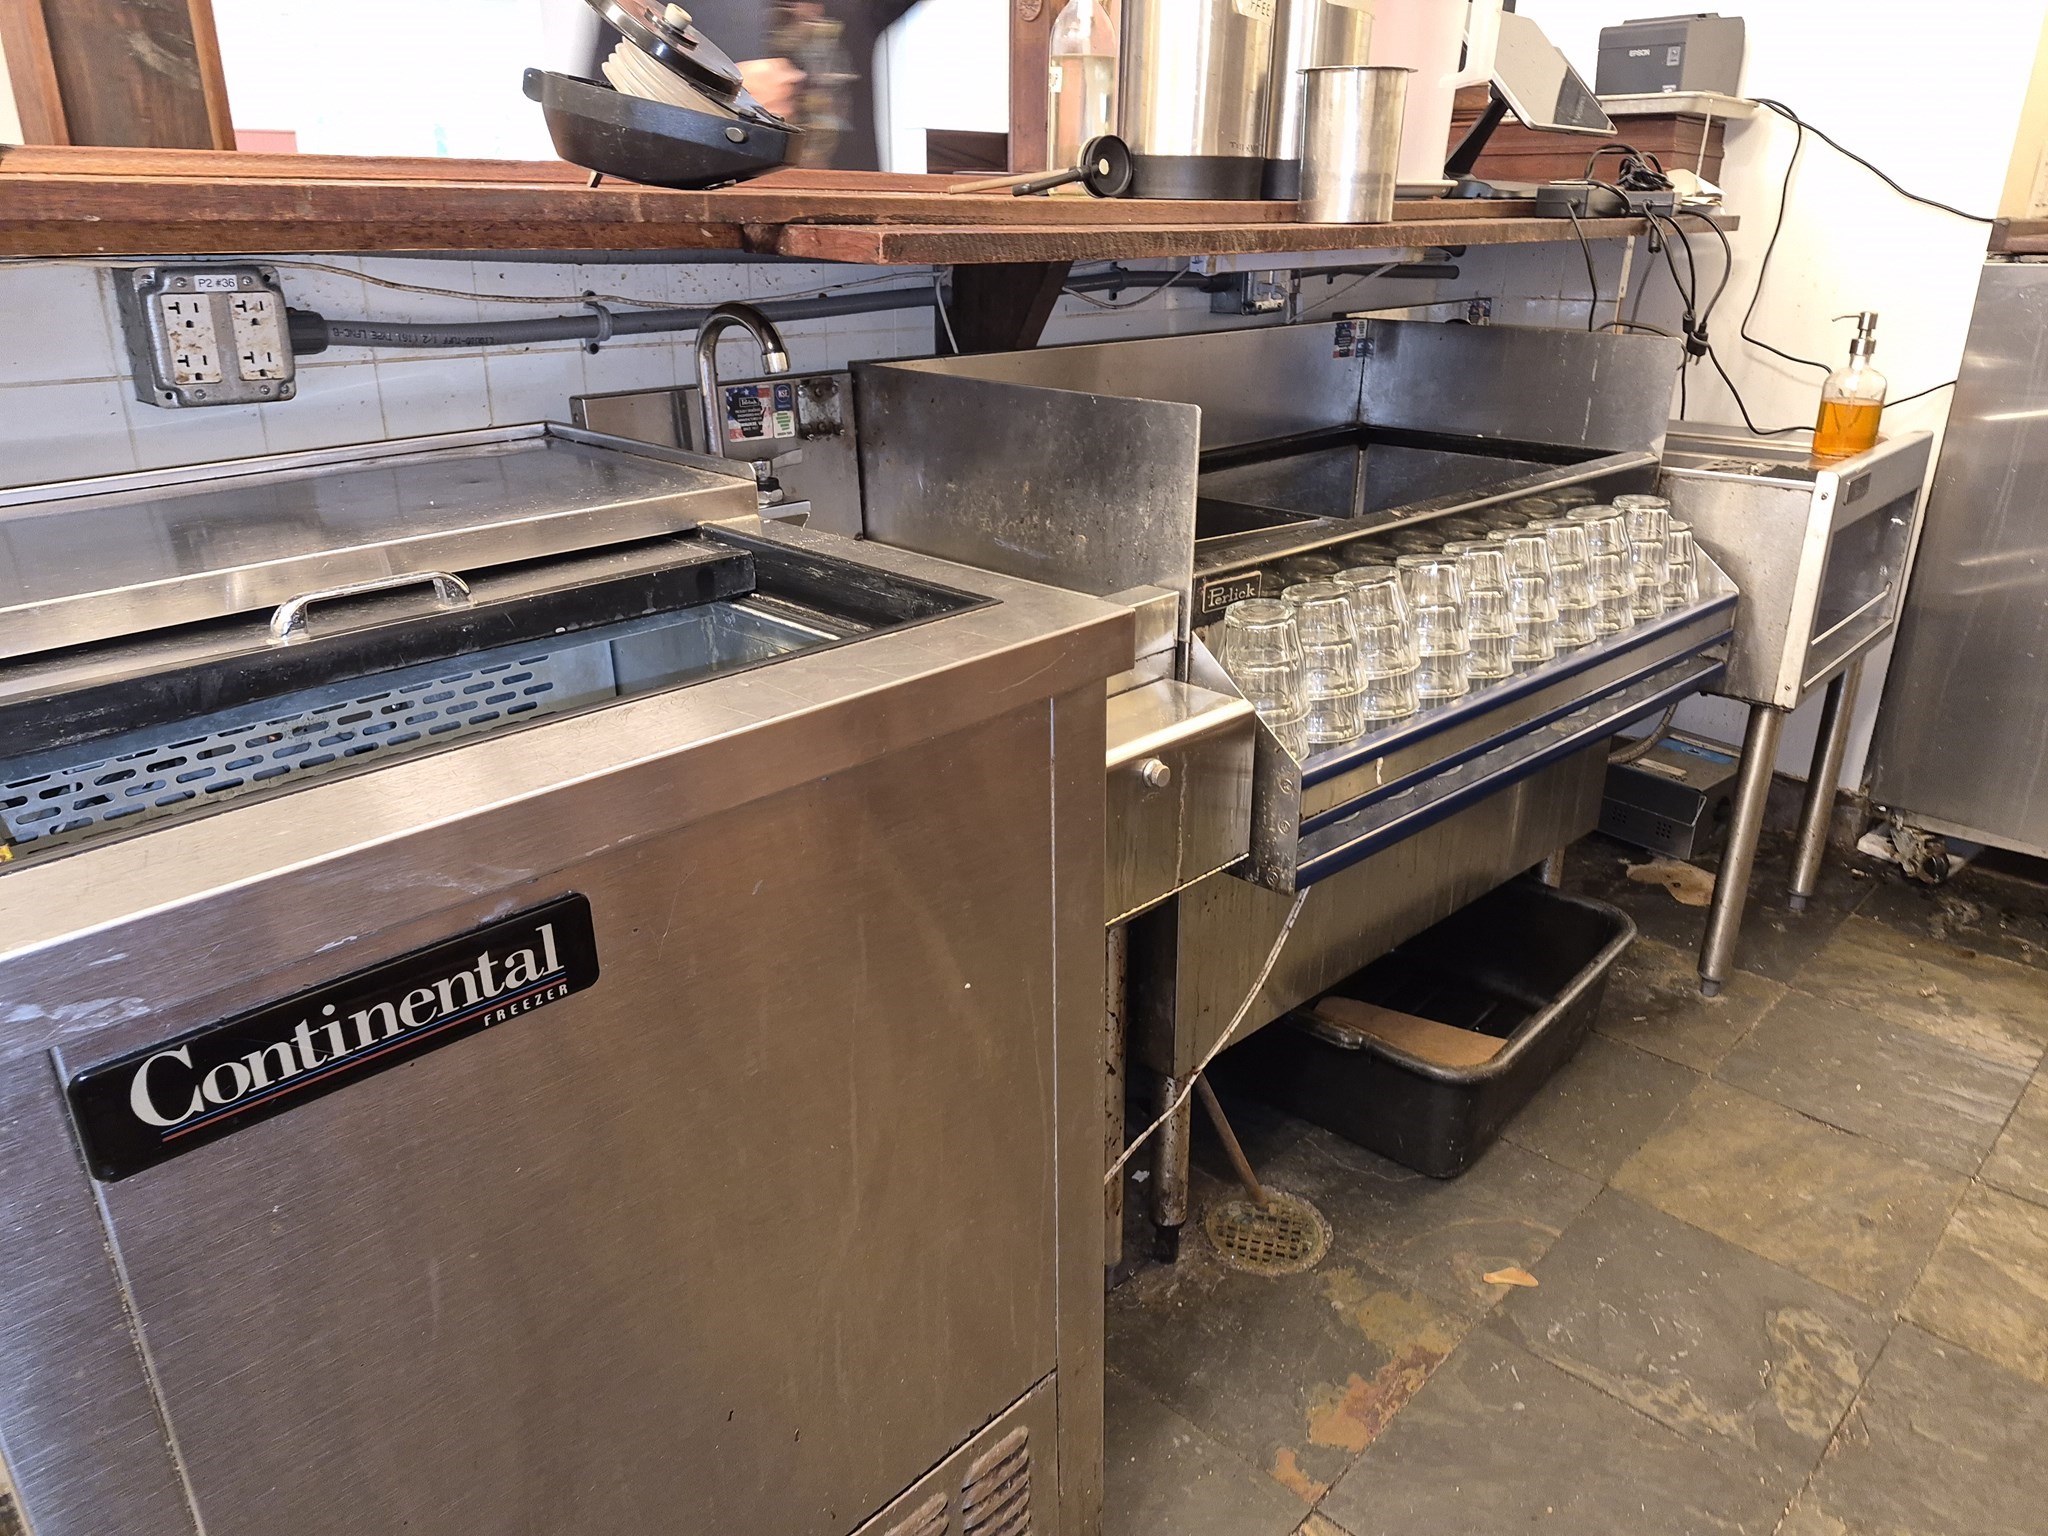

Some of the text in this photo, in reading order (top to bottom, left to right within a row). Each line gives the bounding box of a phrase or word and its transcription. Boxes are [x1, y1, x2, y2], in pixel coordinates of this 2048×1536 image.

[1628, 48, 1651, 57] EPSON
[198, 278, 236, 288] P2 #36
[1208, 583, 1256, 607] Perlick
[483, 984, 569, 1027] FREEZER
[130, 924, 564, 1126] Continental
